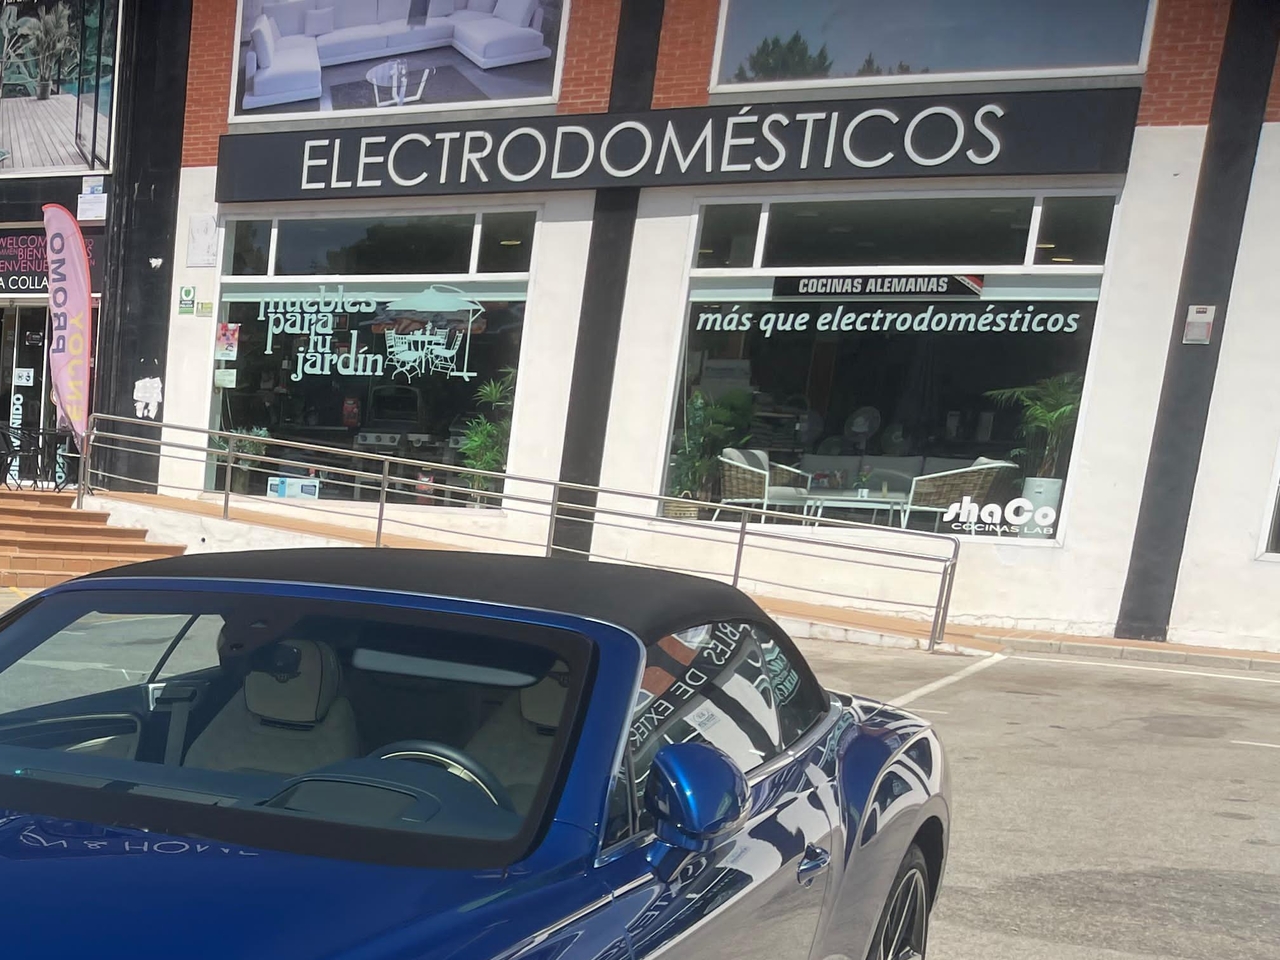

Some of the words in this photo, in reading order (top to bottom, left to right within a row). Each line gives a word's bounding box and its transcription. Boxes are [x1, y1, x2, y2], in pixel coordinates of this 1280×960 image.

[301, 103, 1006, 190] ELECTRODOMÉSTICOS
[18, 248, 47, 260] BIENV
[8, 274, 49, 289] COLLA
[799, 278, 862, 293] COCINAS
[865, 277, 949, 293] ALEMANAS
[258, 285, 377, 320] muebles
[264, 311, 333, 354] para
[696, 304, 752, 331] más
[759, 312, 808, 337] que
[816, 305, 1081, 333] electrodomésticos
[308, 323, 332, 353] tu
[290, 330, 384, 382] jardín
[8, 393, 23, 482] BIEVNIDO
[951, 523, 1020, 533] COCINAS
[1024, 527, 1054, 535] LAB
